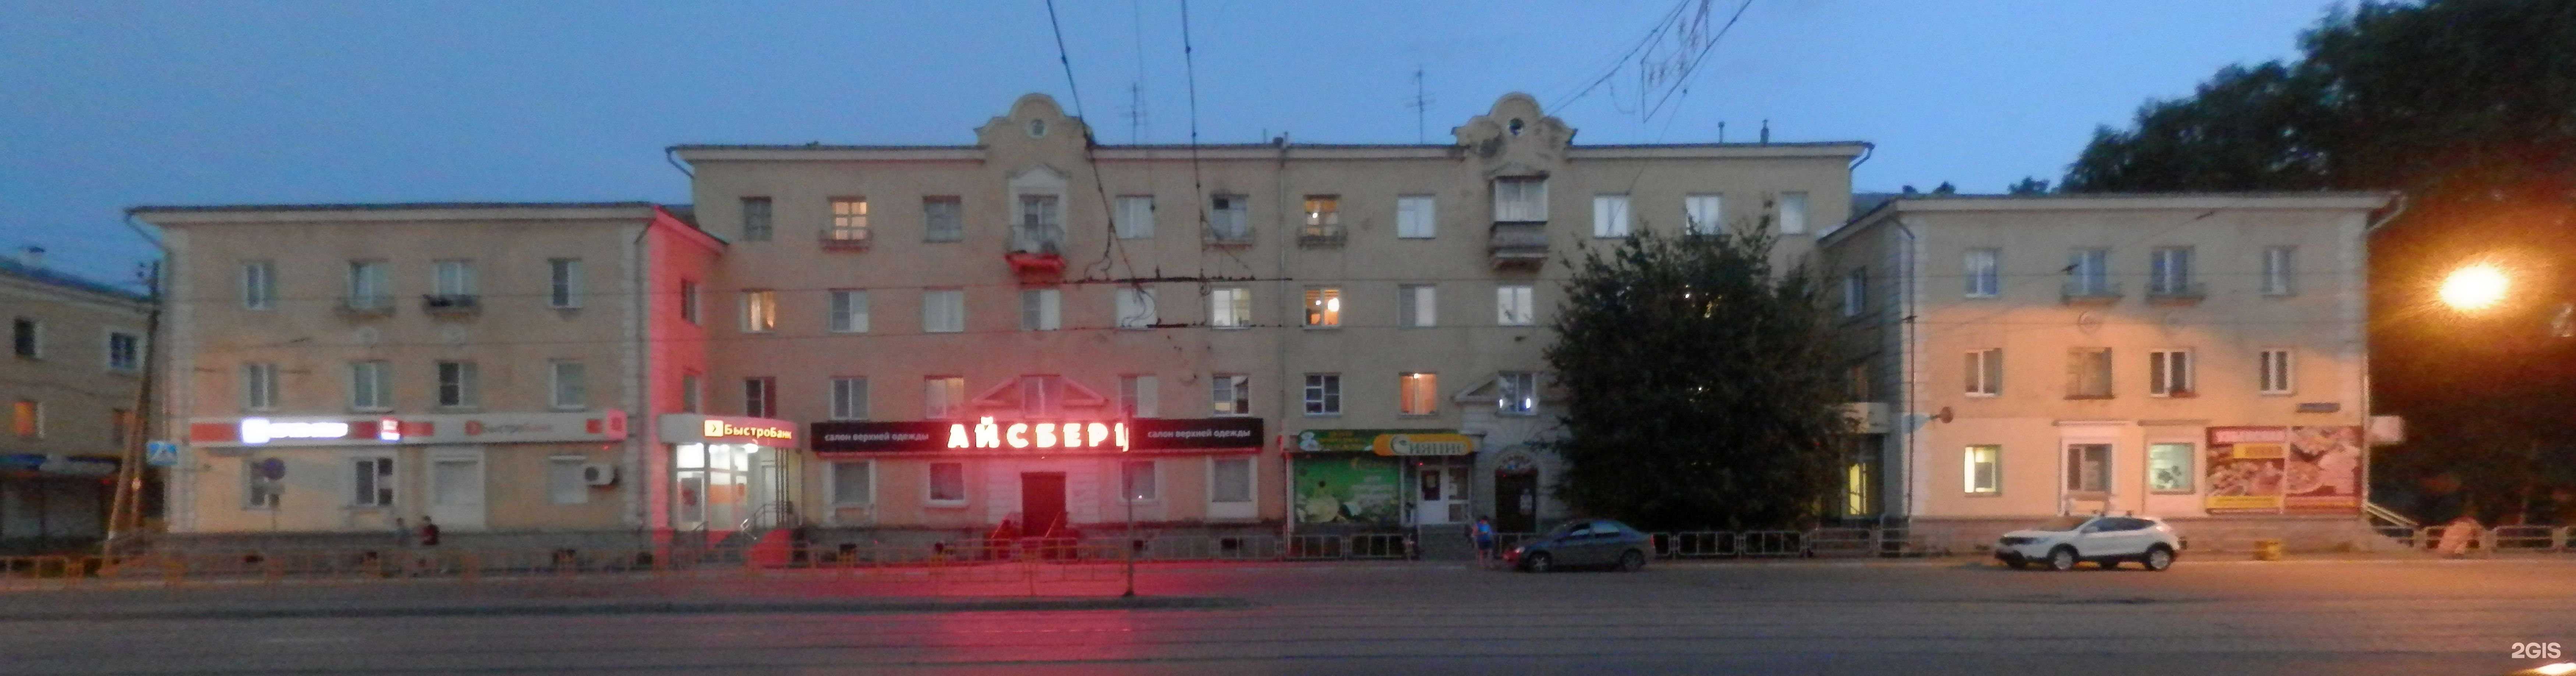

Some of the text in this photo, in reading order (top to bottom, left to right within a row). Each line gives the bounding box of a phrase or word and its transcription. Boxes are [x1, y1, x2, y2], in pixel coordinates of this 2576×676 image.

[724, 424, 792, 439] БыстроБанк
[853, 431, 890, 442] верхней
[1175, 428, 1212, 439] верхней
